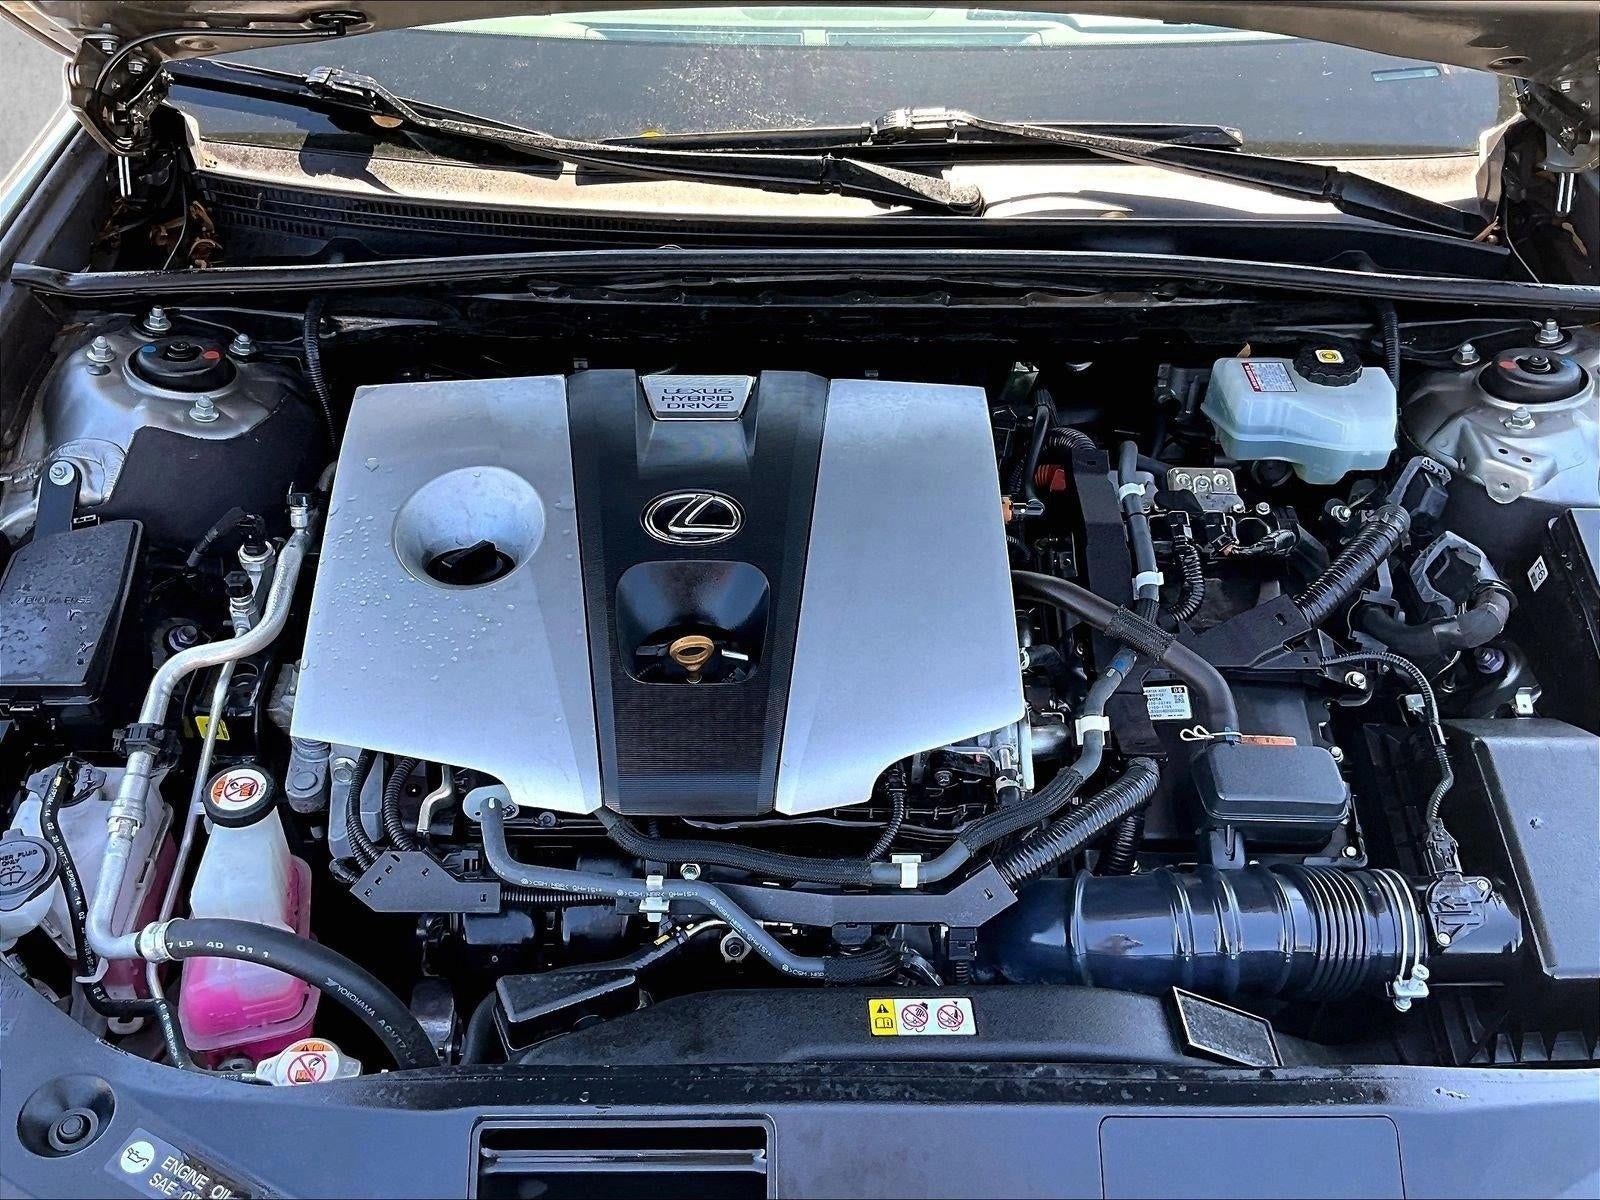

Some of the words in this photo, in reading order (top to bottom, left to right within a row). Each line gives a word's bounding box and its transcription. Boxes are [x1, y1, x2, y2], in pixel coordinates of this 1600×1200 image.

[337, 984, 376, 1017] YOKOHAMA
[148, 1172, 179, 1196] SAE
[160, 1155, 210, 1190] ENGINE
